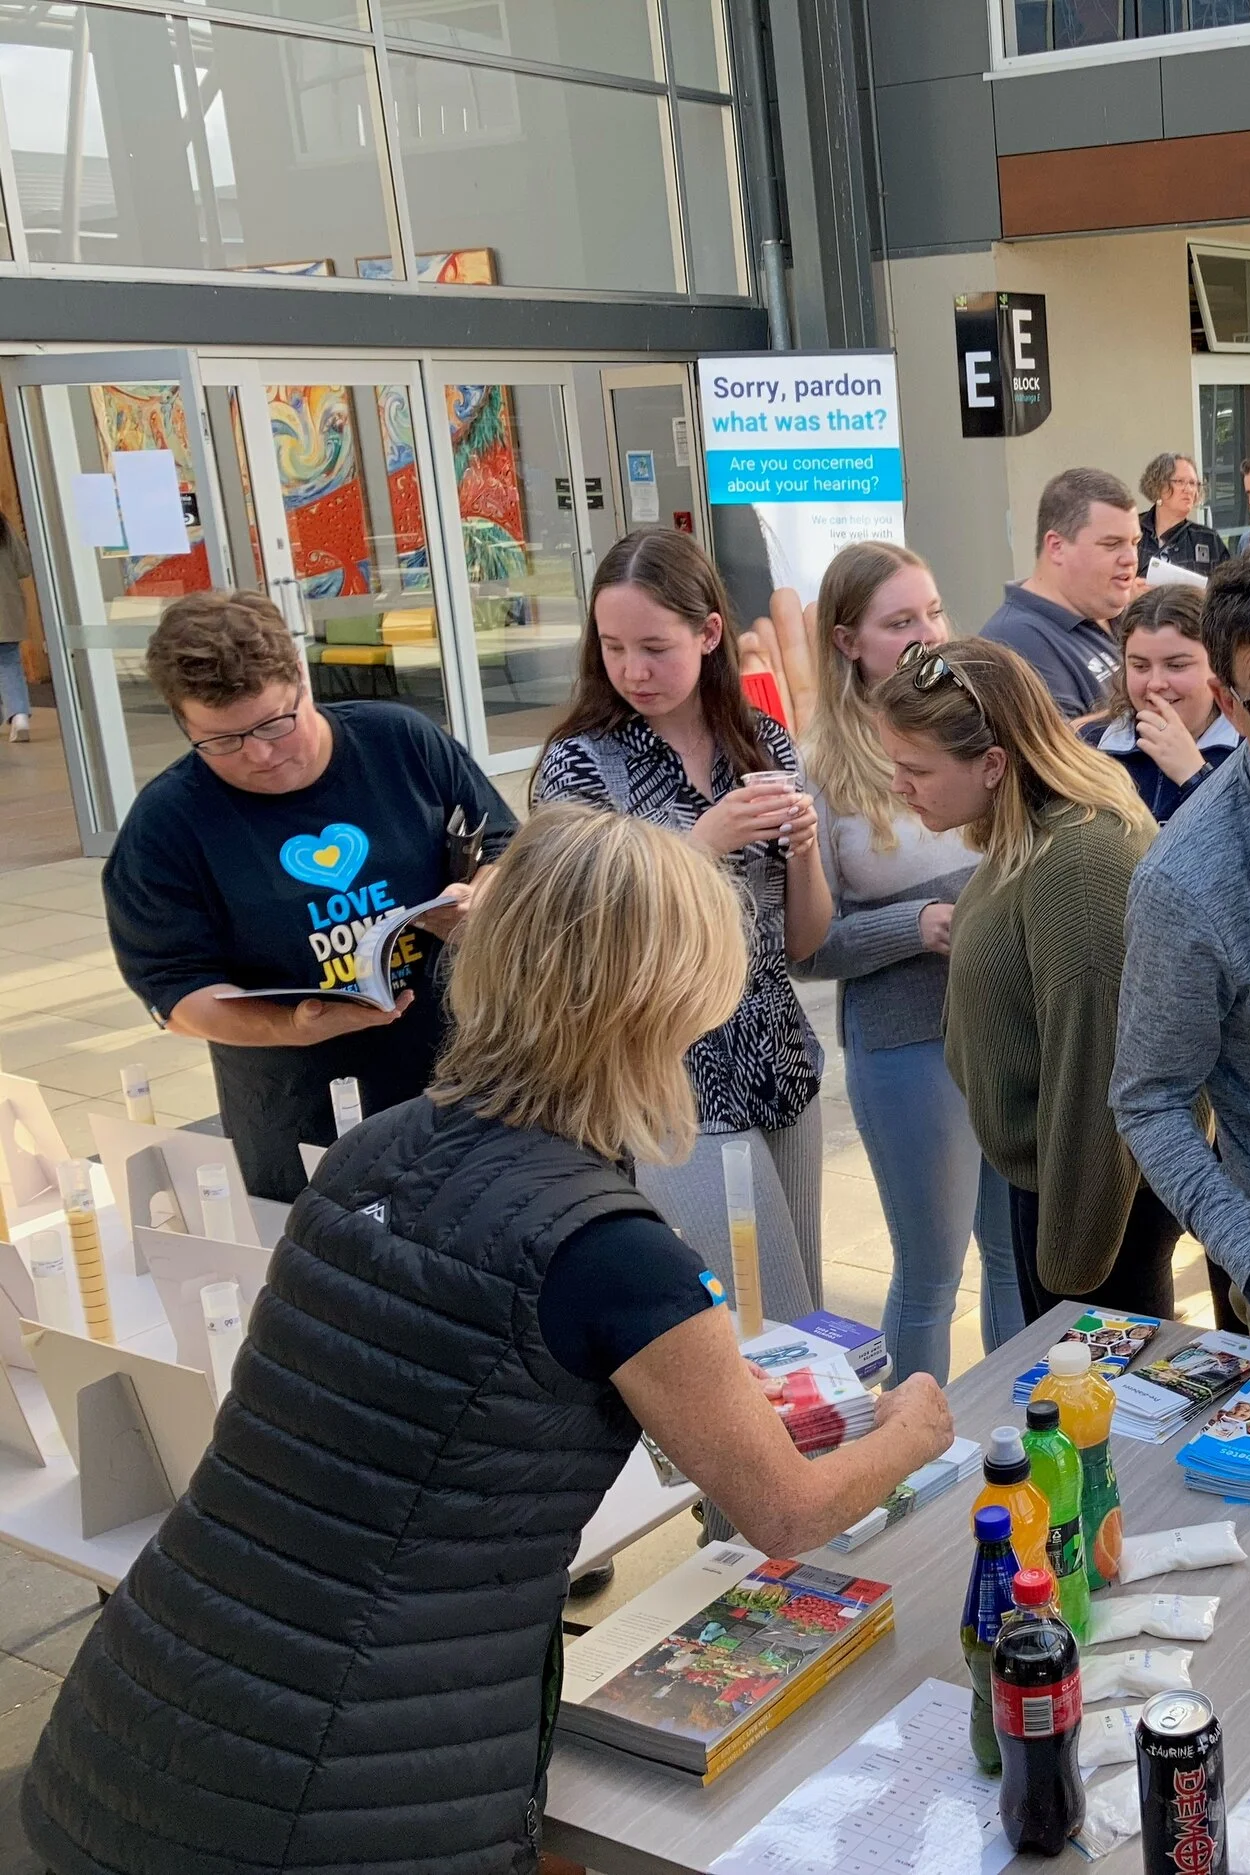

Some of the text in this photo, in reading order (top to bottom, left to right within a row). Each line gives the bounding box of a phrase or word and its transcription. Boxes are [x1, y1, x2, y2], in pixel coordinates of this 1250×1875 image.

[1012, 309, 1036, 369] E
[713, 373, 882, 403] Sorry, pardon
[965, 351, 995, 408] E
[1013, 377, 1040, 391] BLOCK
[712, 408, 888, 433] what was that?
[730, 455, 873, 474] Are you concerned
[727, 476, 879, 495] about your hearing?
[812, 514, 893, 526] We can help you
[830, 529, 846, 538] live
[872, 529, 893, 538] with
[307, 880, 395, 930] LOVE
[320, 933, 422, 990] JUE
[1165, 1762, 1218, 1875] DEMO
